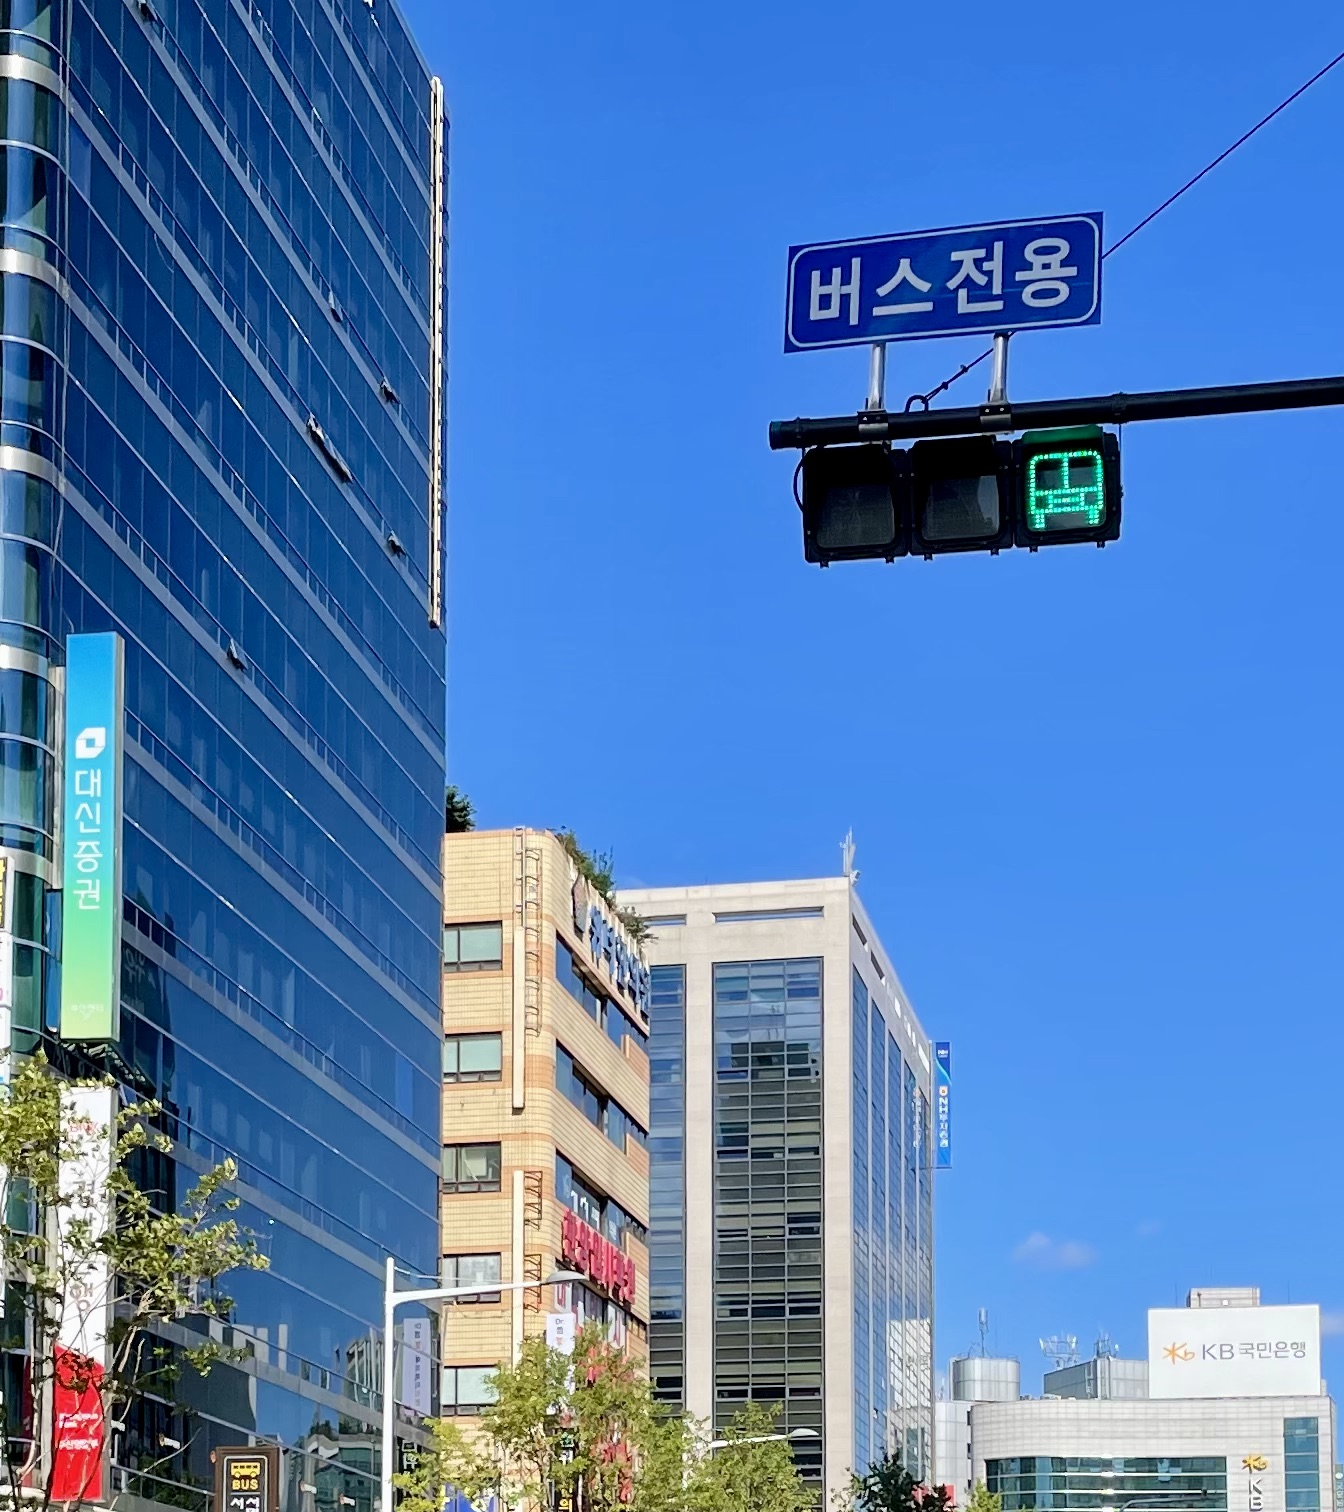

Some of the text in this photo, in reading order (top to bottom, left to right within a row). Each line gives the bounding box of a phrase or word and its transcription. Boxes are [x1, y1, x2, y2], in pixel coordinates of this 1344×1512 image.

[809, 236, 1078, 326] 버스전용
[72, 767, 104, 911] 대신증권
[1202, 1340, 1307, 1361] KB 국민은행
[231, 1479, 259, 1490] BUS
